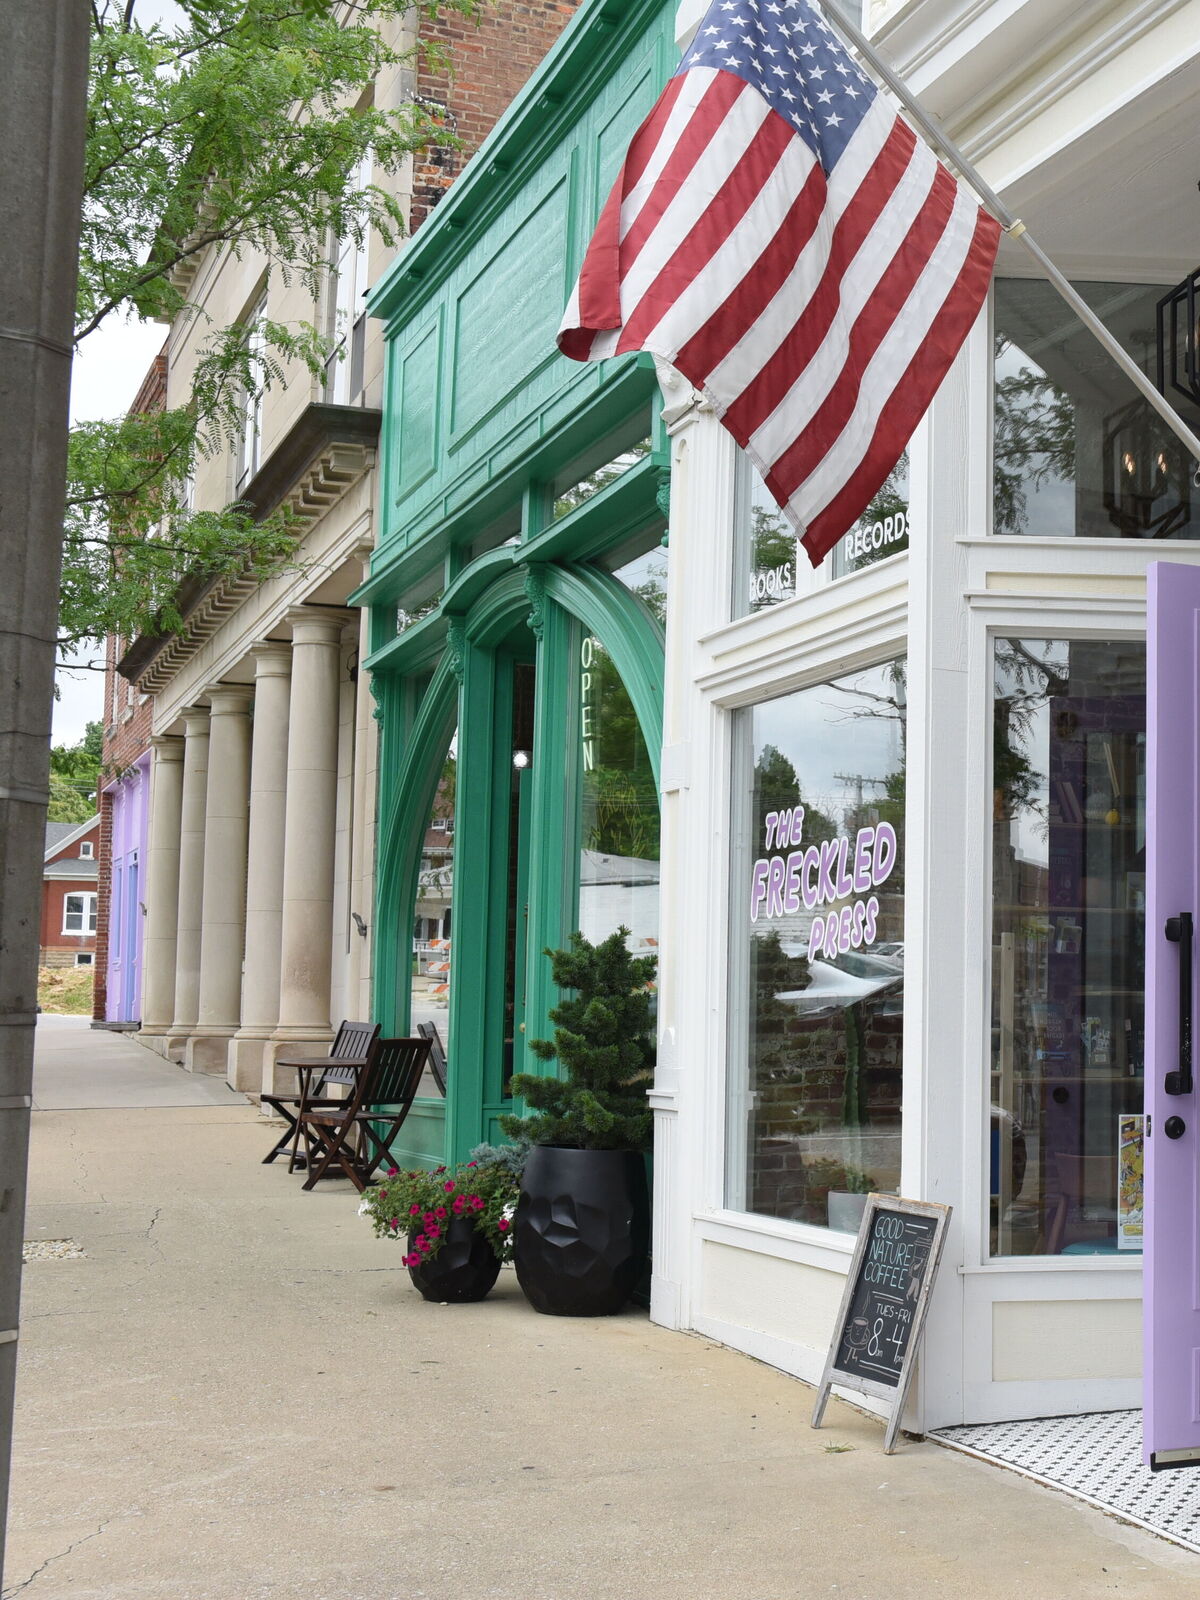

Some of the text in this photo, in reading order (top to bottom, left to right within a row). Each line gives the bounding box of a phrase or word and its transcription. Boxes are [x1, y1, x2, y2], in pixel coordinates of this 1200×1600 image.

[750, 562, 791, 601] BOOKS
[581, 637, 594, 772] OPEN
[765, 806, 805, 851] THE
[751, 821, 897, 923] FRECKLED
[808, 896, 879, 963] PRESS
[874, 1216, 905, 1239] GOOD
[868, 1239, 914, 1266] NATURE
[864, 1261, 909, 1290] COFFEE
